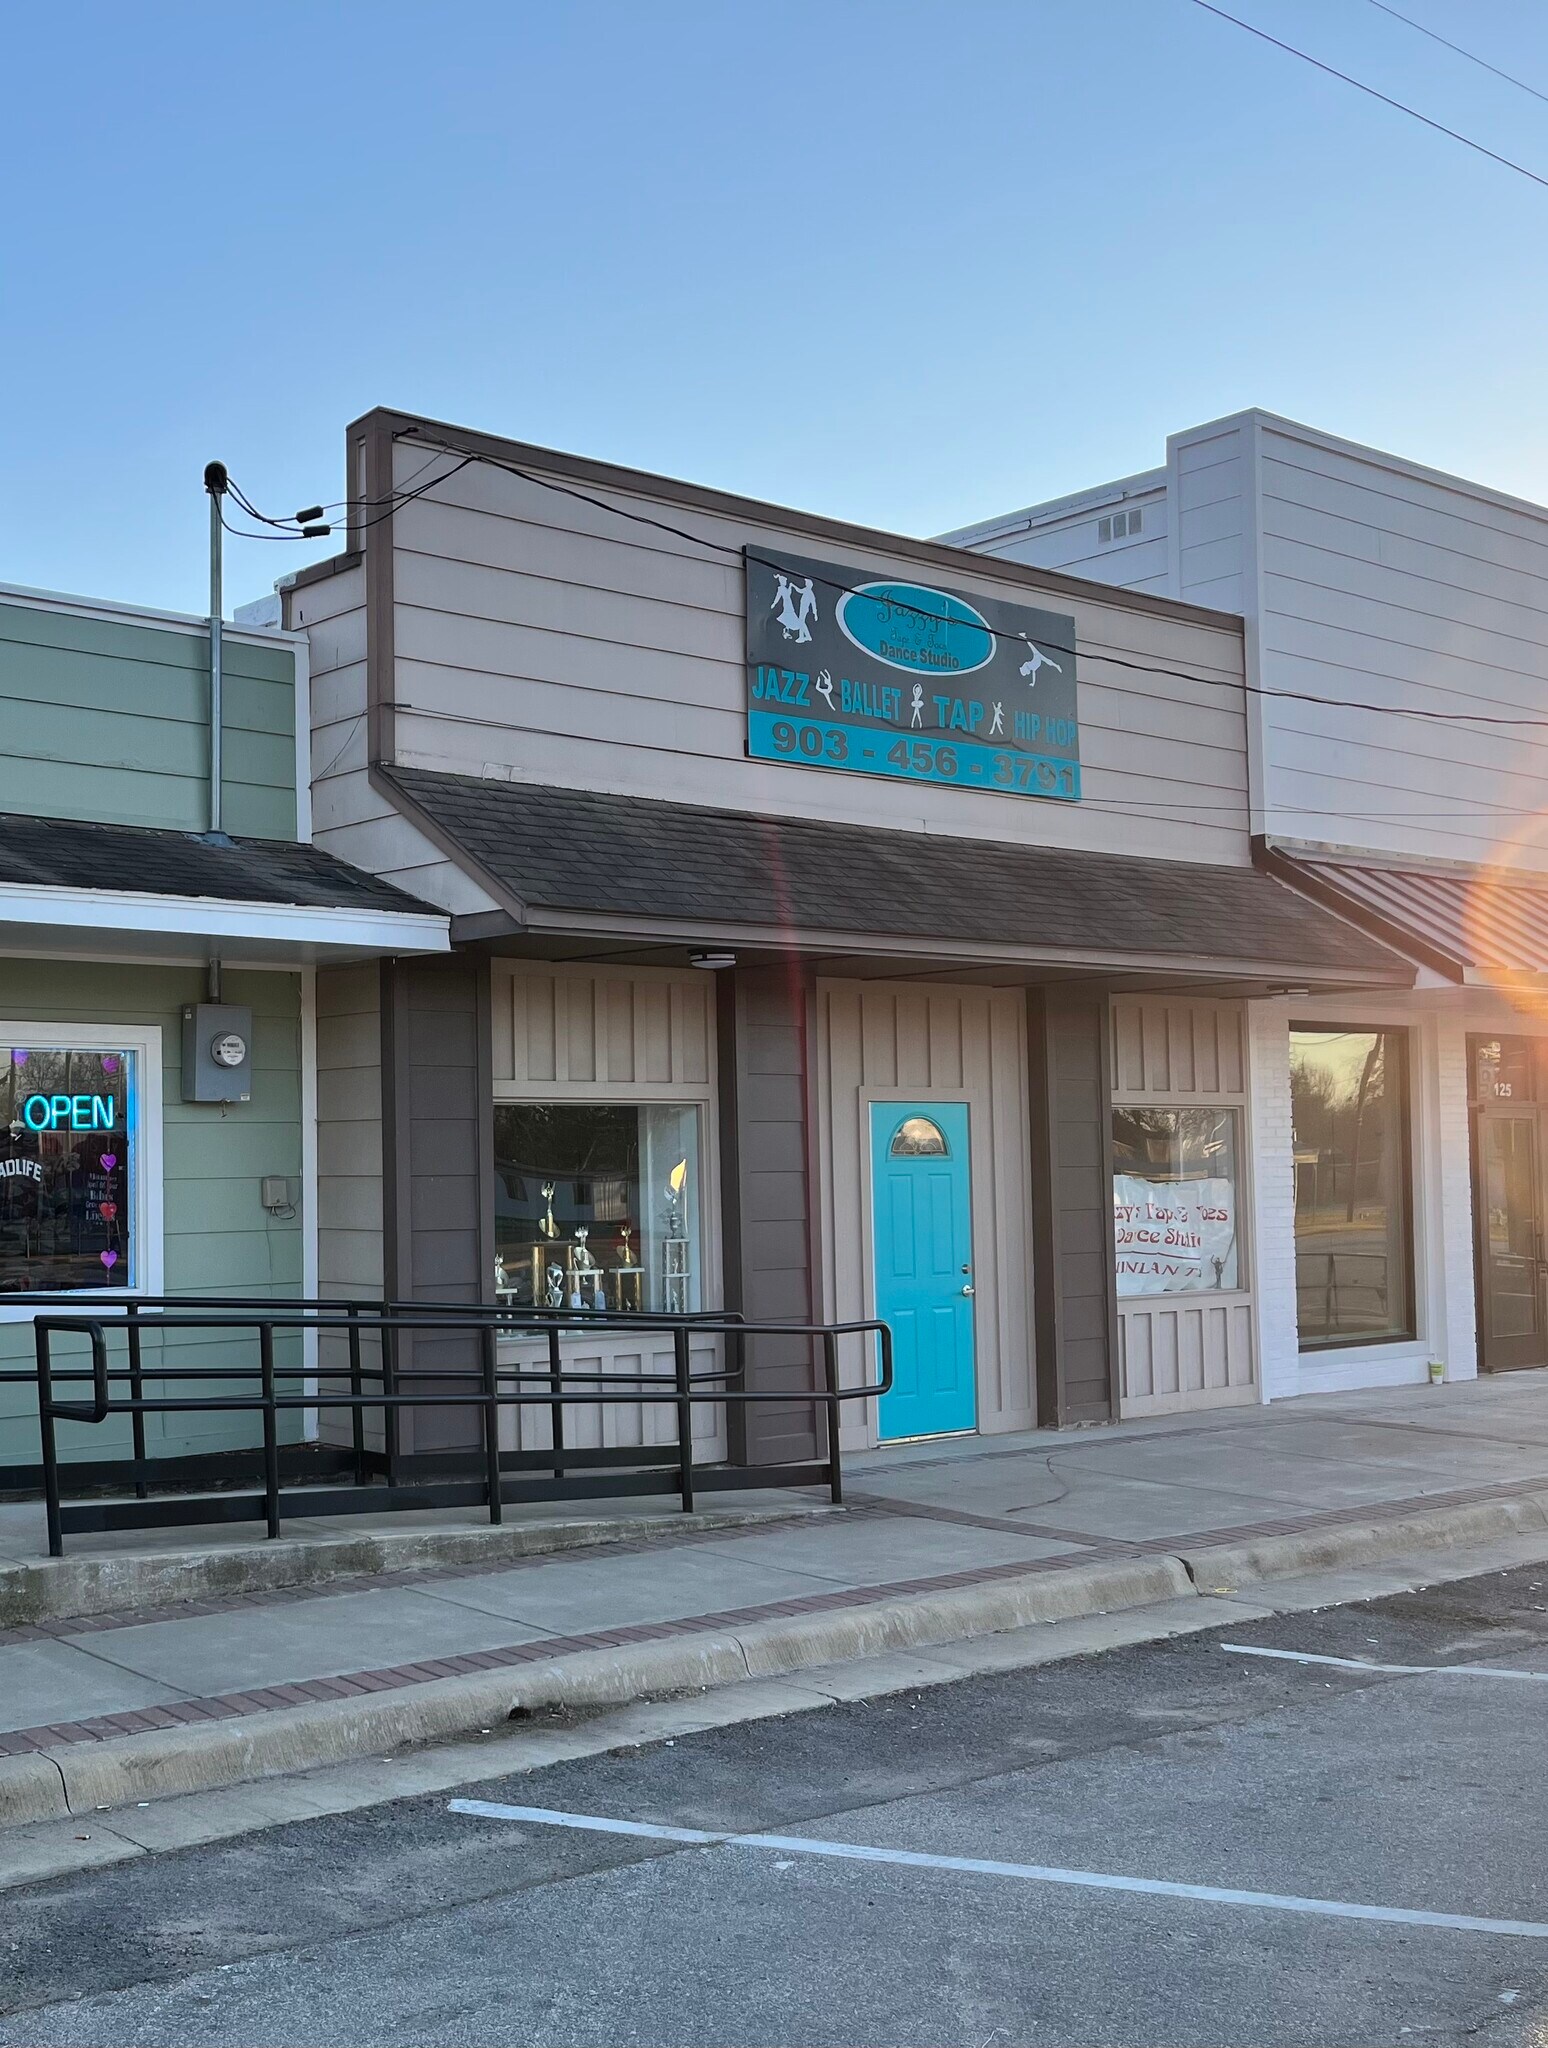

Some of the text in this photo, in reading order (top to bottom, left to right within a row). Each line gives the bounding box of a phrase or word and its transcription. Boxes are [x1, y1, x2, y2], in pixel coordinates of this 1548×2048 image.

[879, 640, 960, 669] Dance Studio
[751, 666, 1076, 747] JAZZ BALLET TAP HIP HOP
[771, 721, 848, 761] 903
[887, 739, 958, 776] 456
[993, 755, 1075, 794] 3791
[1494, 1082, 1512, 1097] 125
[23, 1094, 115, 1131] OPEN
